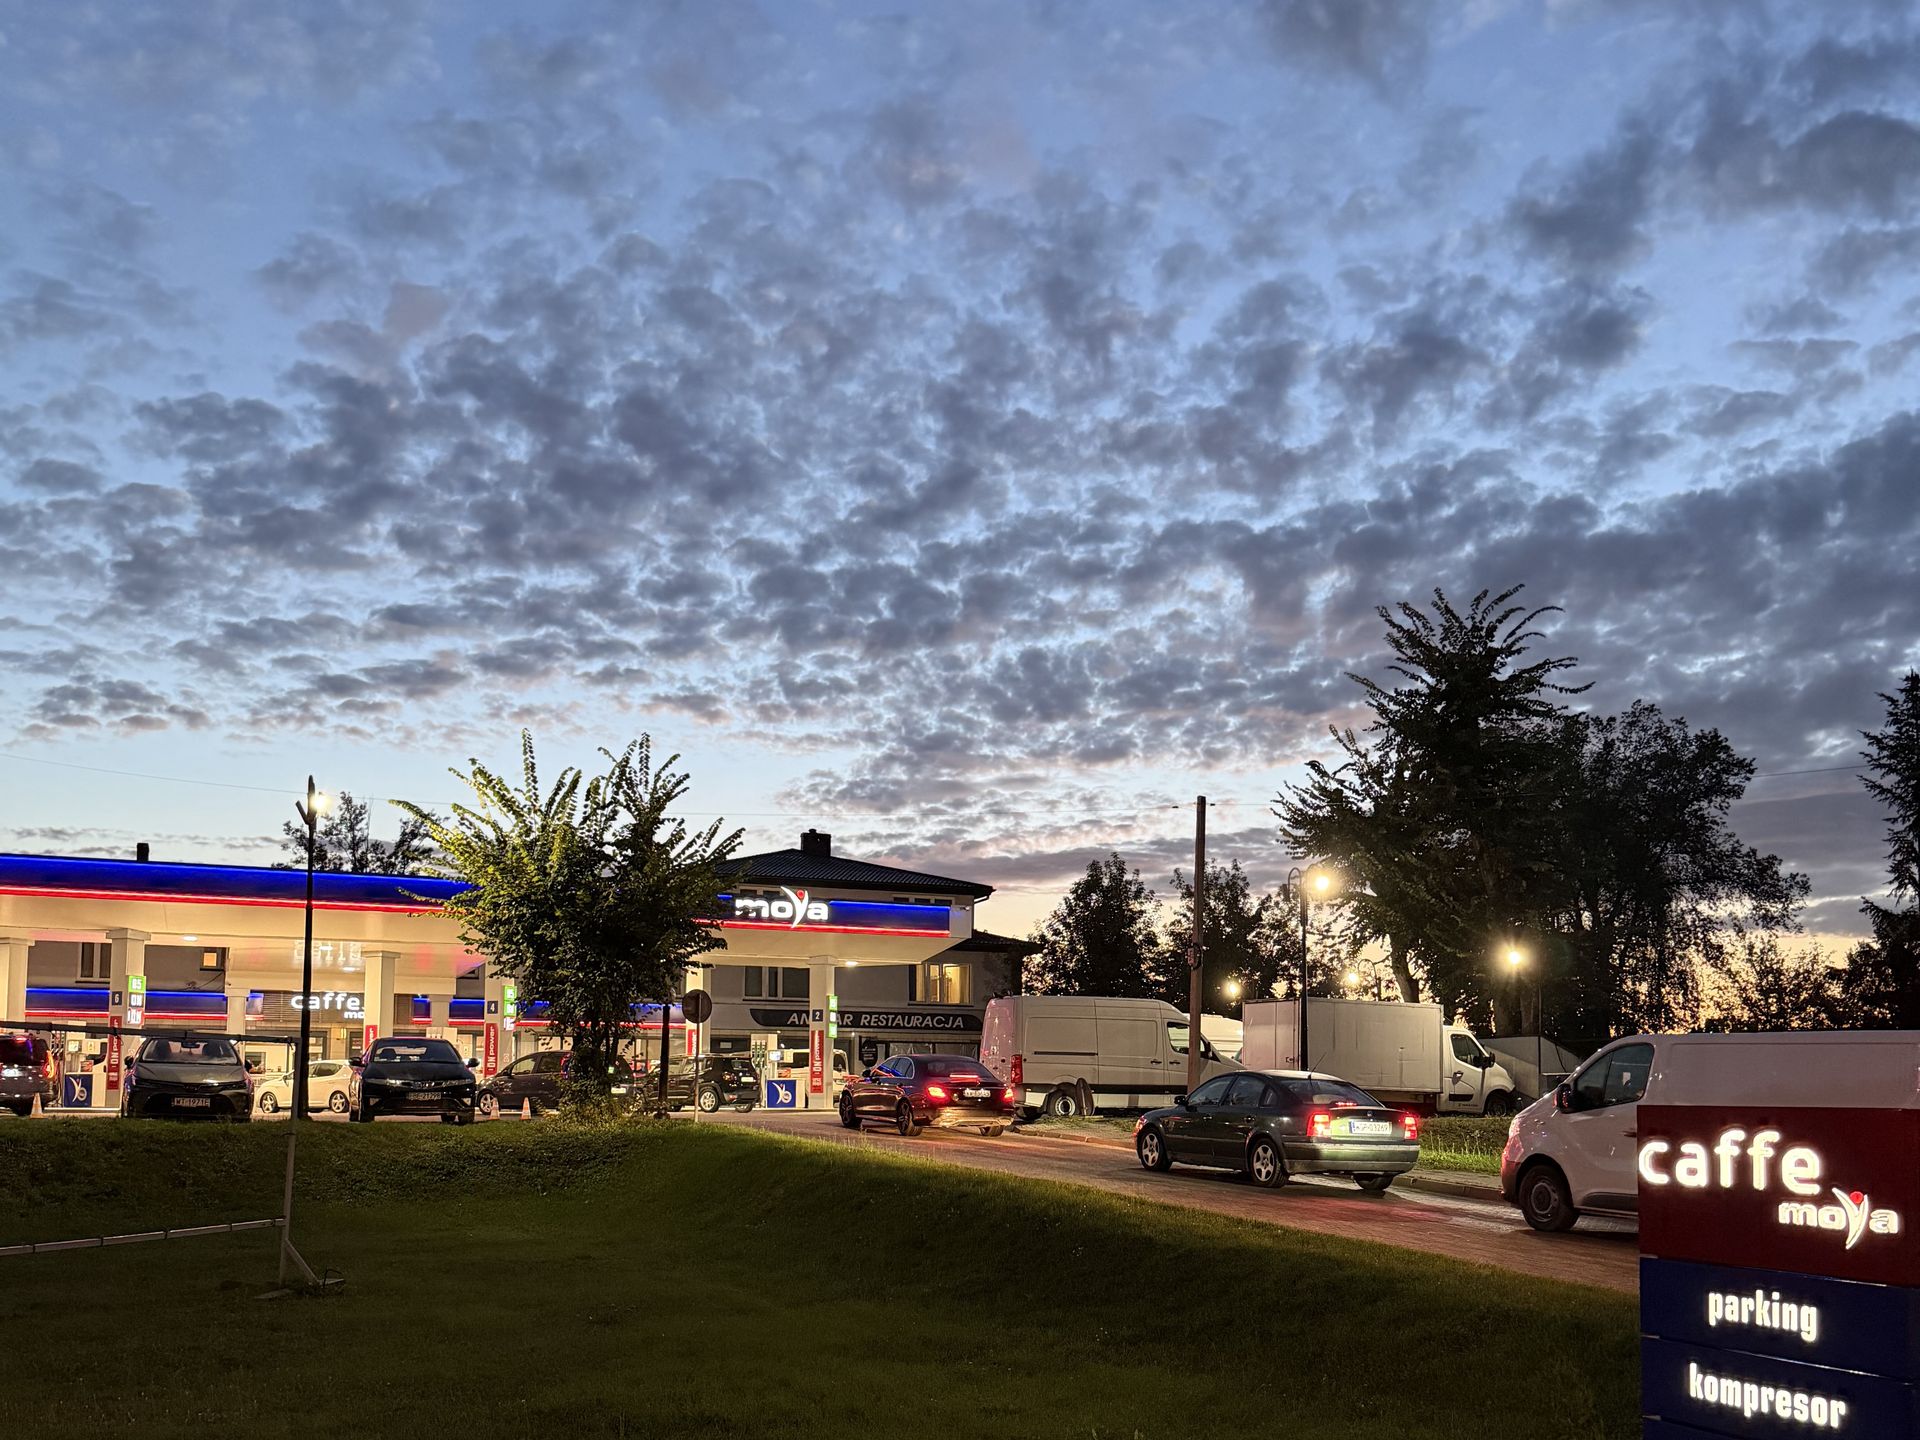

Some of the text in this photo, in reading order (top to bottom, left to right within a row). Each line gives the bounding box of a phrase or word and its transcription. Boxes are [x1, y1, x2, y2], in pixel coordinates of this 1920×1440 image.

[735, 886, 829, 929] moya
[114, 993, 120, 1003] 6
[290, 992, 360, 1011] caffe
[490, 1002, 496, 1012] 4
[815, 1011, 820, 1020] 2
[860, 1014, 965, 1029] RESTAURACJA
[1638, 1129, 1820, 1195] caffe
[1778, 1187, 1899, 1250] moya
[1708, 1289, 1817, 1342] parking
[1689, 1362, 1846, 1428] kompresor
